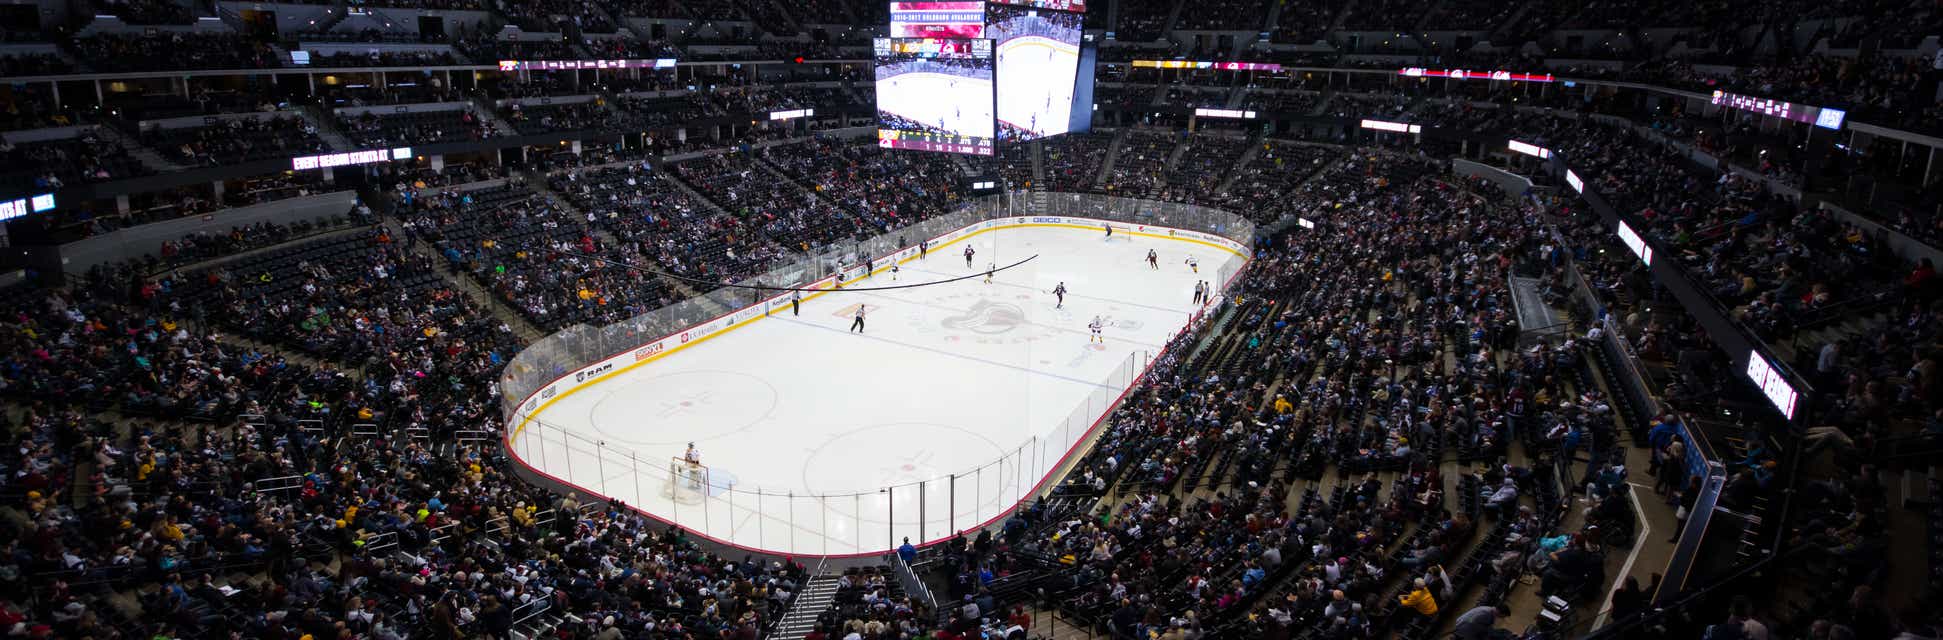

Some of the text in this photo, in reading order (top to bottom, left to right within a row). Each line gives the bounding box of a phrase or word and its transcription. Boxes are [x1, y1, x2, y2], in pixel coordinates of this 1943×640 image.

[293, 156, 319, 170] EVERY
[319, 153, 350, 167] SEASON
[350, 150, 378, 164] STARTS
[378, 149, 388, 161] AT
[14, 198, 27, 217] AT
[587, 363, 613, 377] RAM
[1747, 349, 1769, 389] EVERY
[1763, 367, 1793, 416] SEASON
